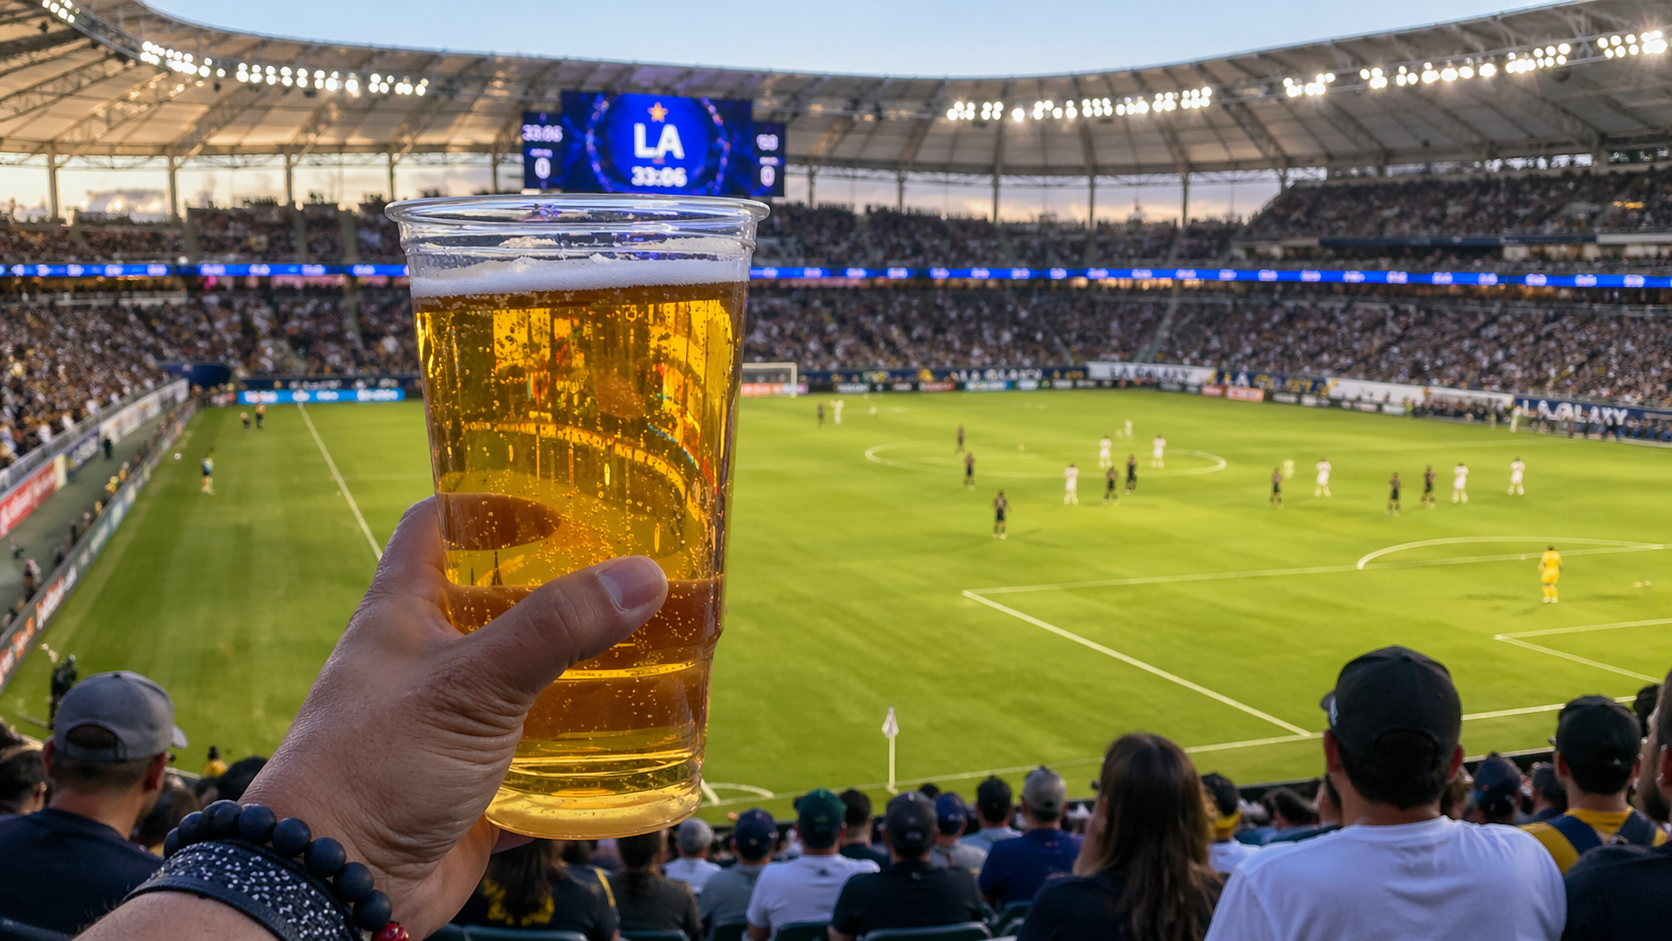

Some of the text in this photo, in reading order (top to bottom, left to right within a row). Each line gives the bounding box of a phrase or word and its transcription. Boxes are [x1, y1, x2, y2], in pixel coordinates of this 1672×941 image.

[634, 122, 685, 160] LA
[535, 157, 551, 179] 0
[631, 166, 688, 188] 33:06
[760, 165, 775, 187] 0
